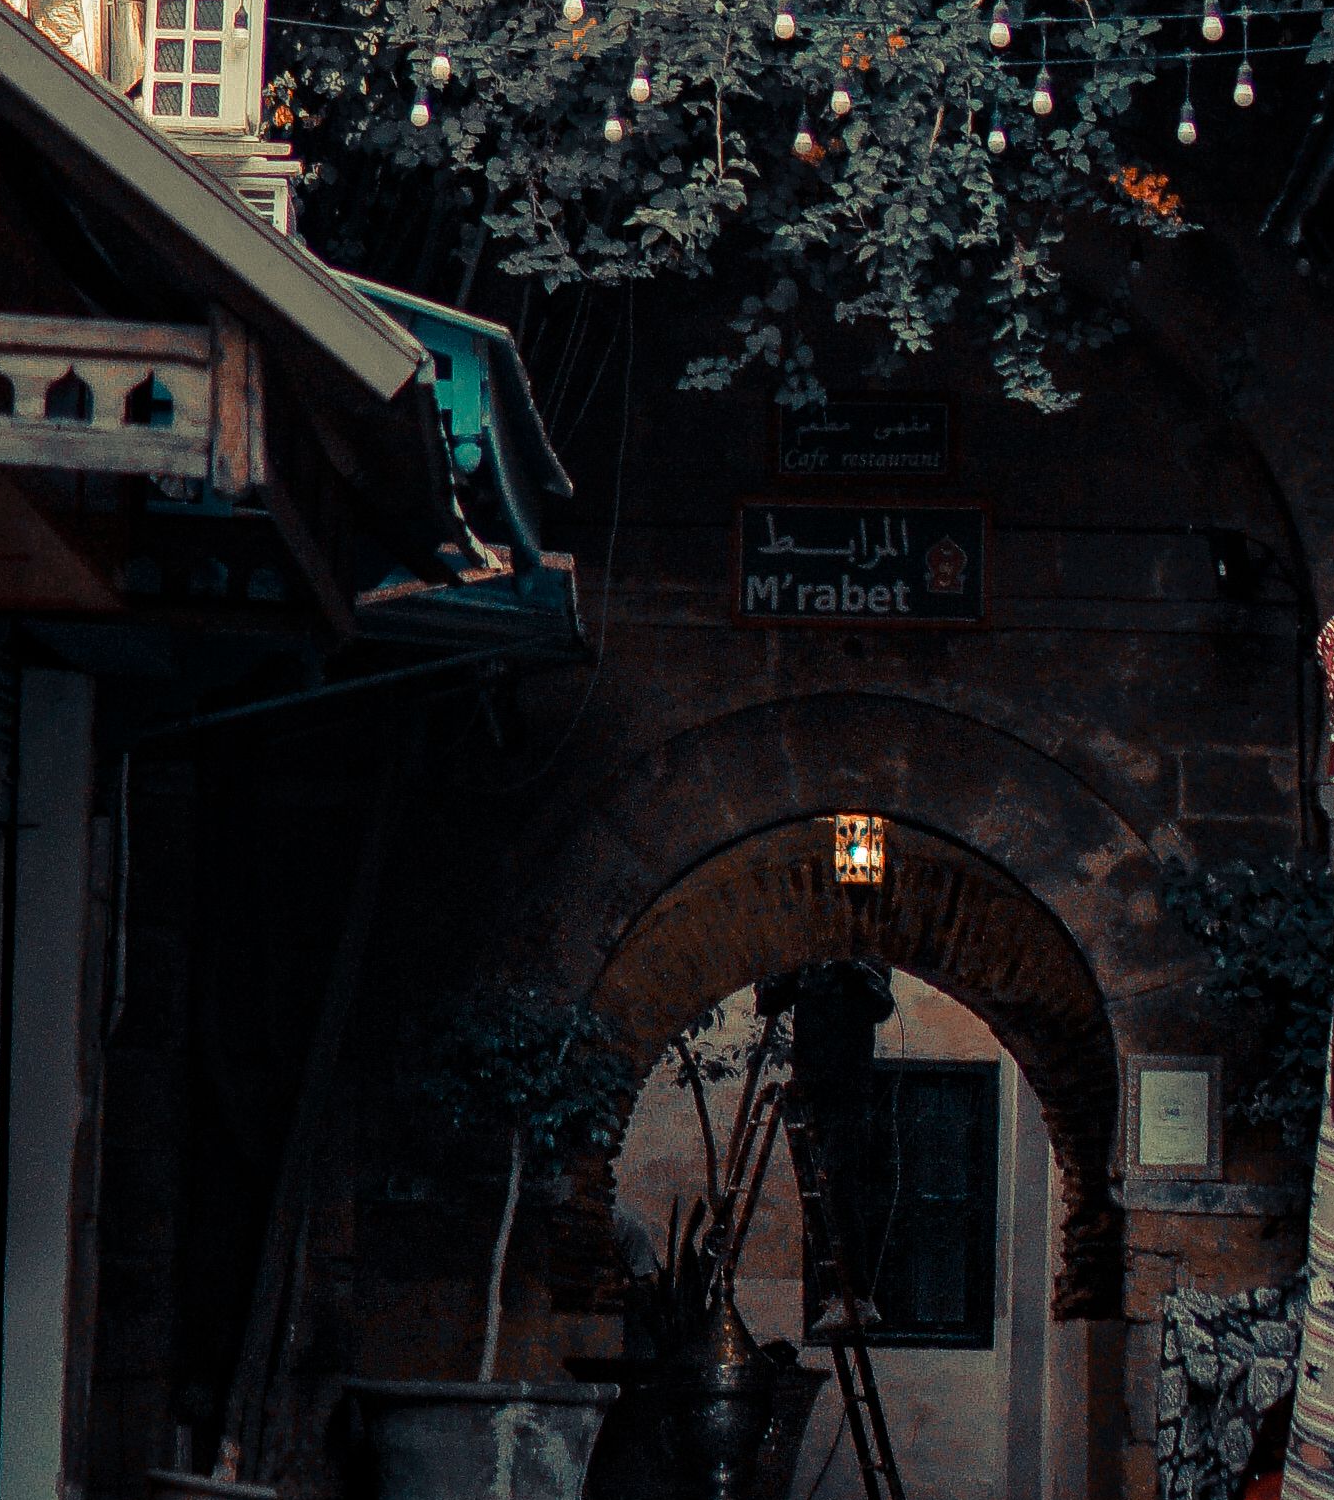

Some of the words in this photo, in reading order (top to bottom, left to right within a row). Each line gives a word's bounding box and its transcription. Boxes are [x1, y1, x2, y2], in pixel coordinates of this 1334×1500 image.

[841, 452, 941, 468] restaurant
[757, 512, 909, 570] المرابط
[746, 572, 911, 612] M'rabet
